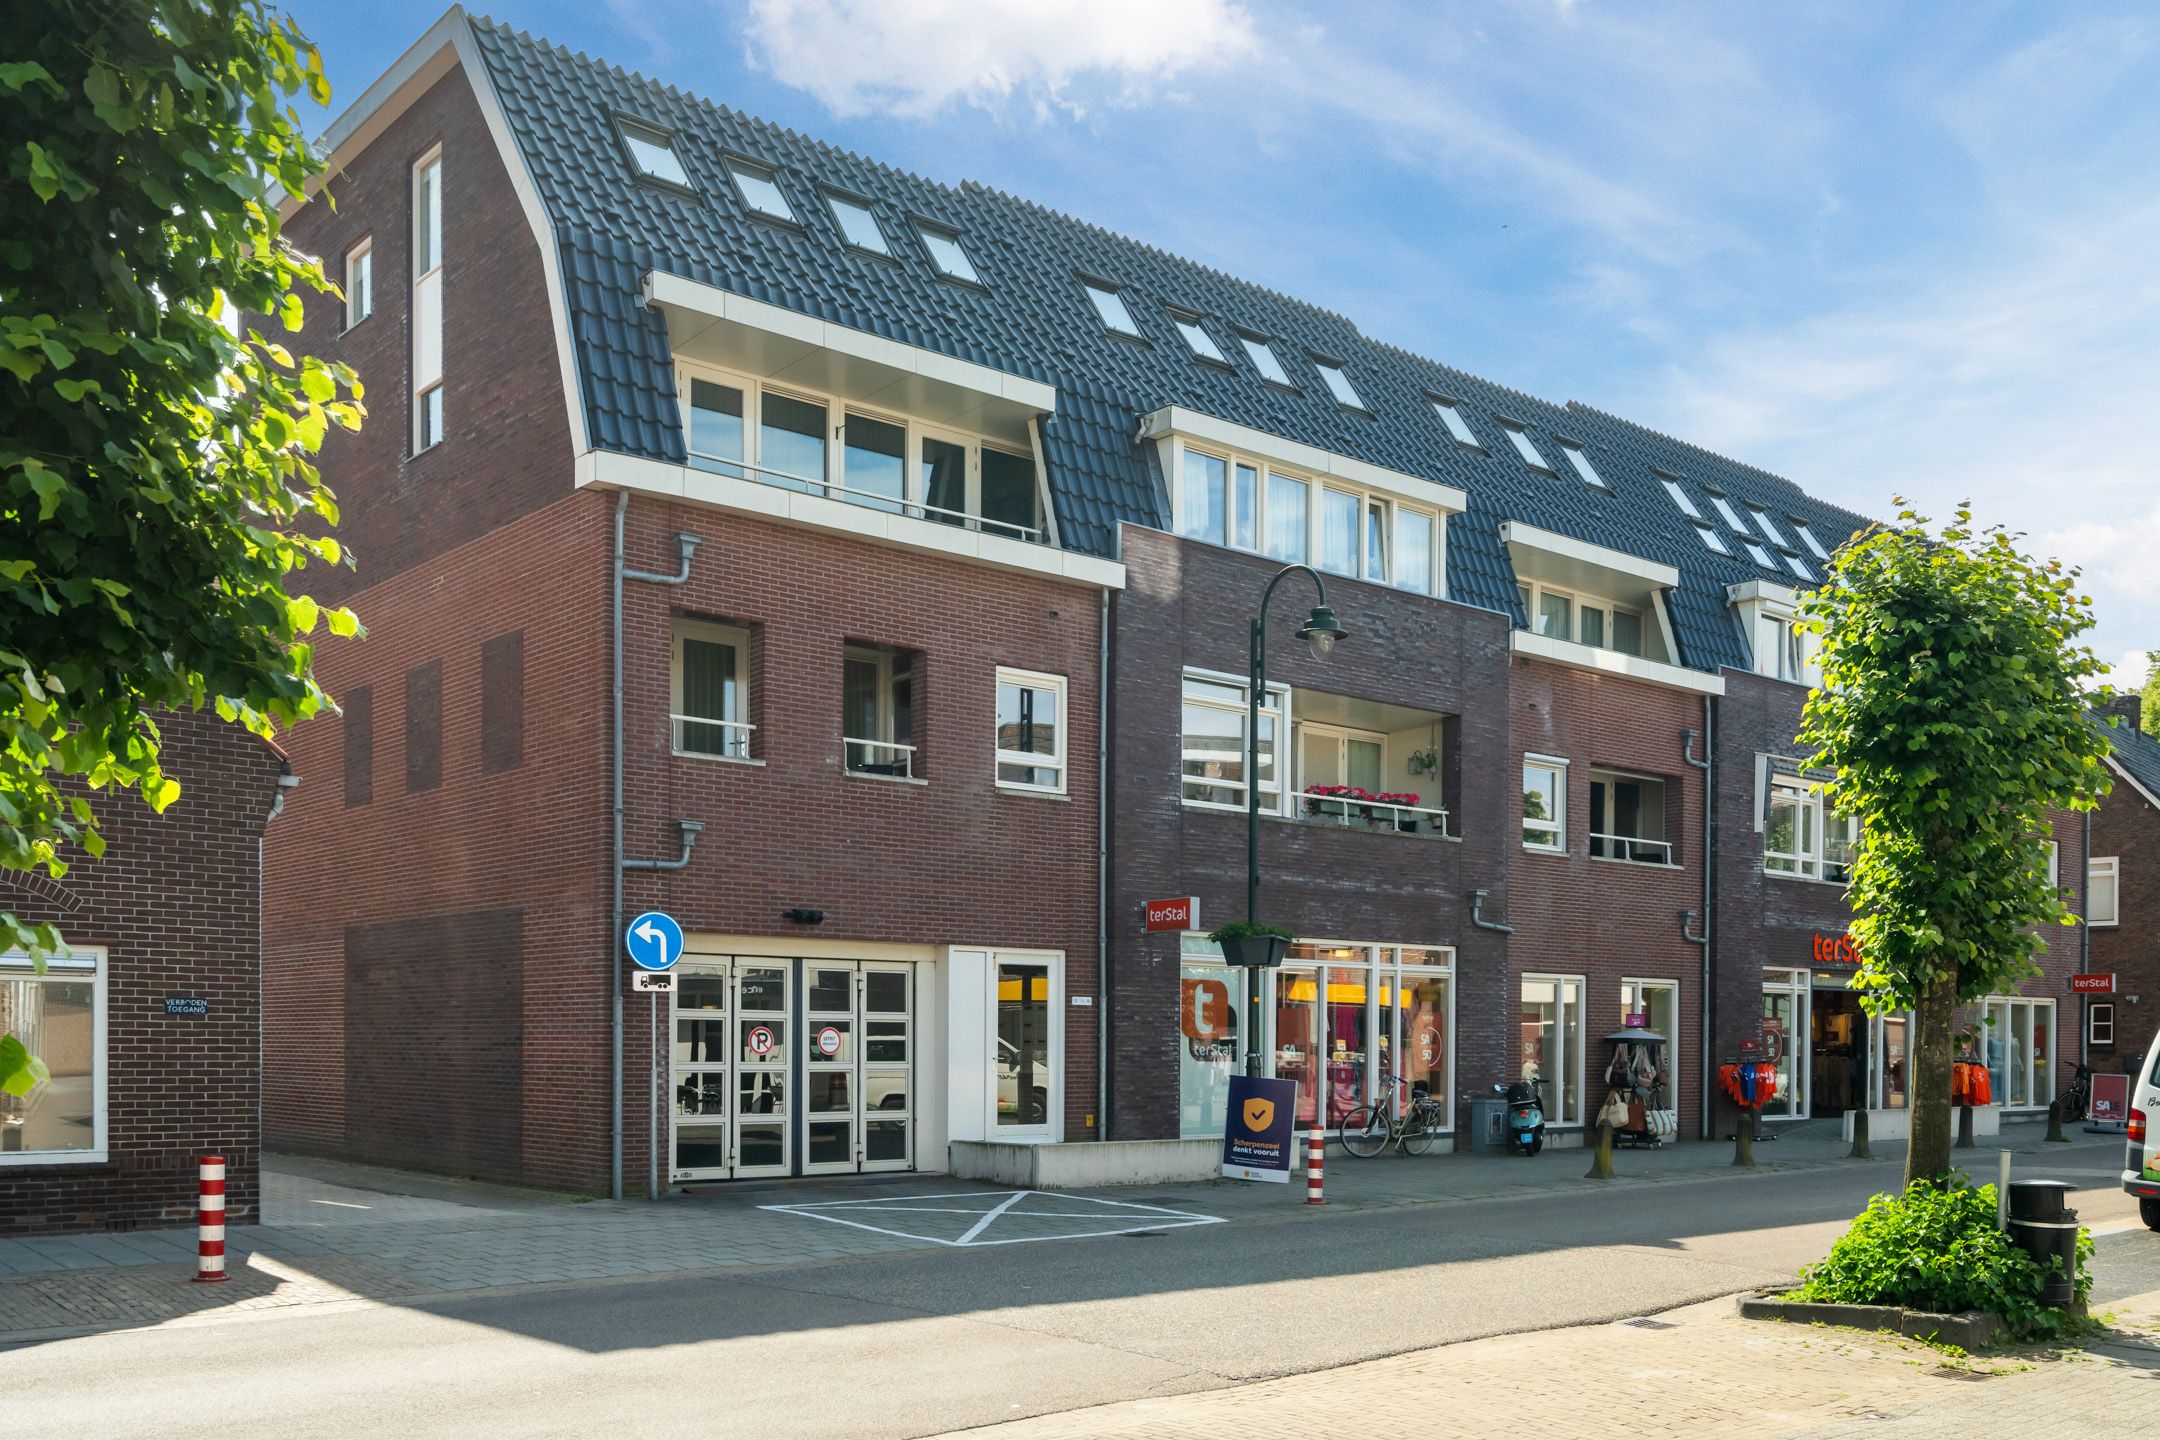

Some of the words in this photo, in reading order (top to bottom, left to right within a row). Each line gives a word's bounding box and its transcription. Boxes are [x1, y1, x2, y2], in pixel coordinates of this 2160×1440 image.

[1150, 905, 1187, 922] terStal
[1813, 932, 1864, 963] terSt
[2074, 978, 2110, 988] terStal
[167, 1005, 206, 1013] TOEGANG
[1195, 983, 1213, 1034] t
[757, 1032, 768, 1050] P
[1194, 1044, 1233, 1057] terStal
[1233, 1138, 1280, 1150] Scherpenzeel
[1232, 1145, 1252, 1154] denkt
[1253, 1148, 1280, 1157] vooruit
